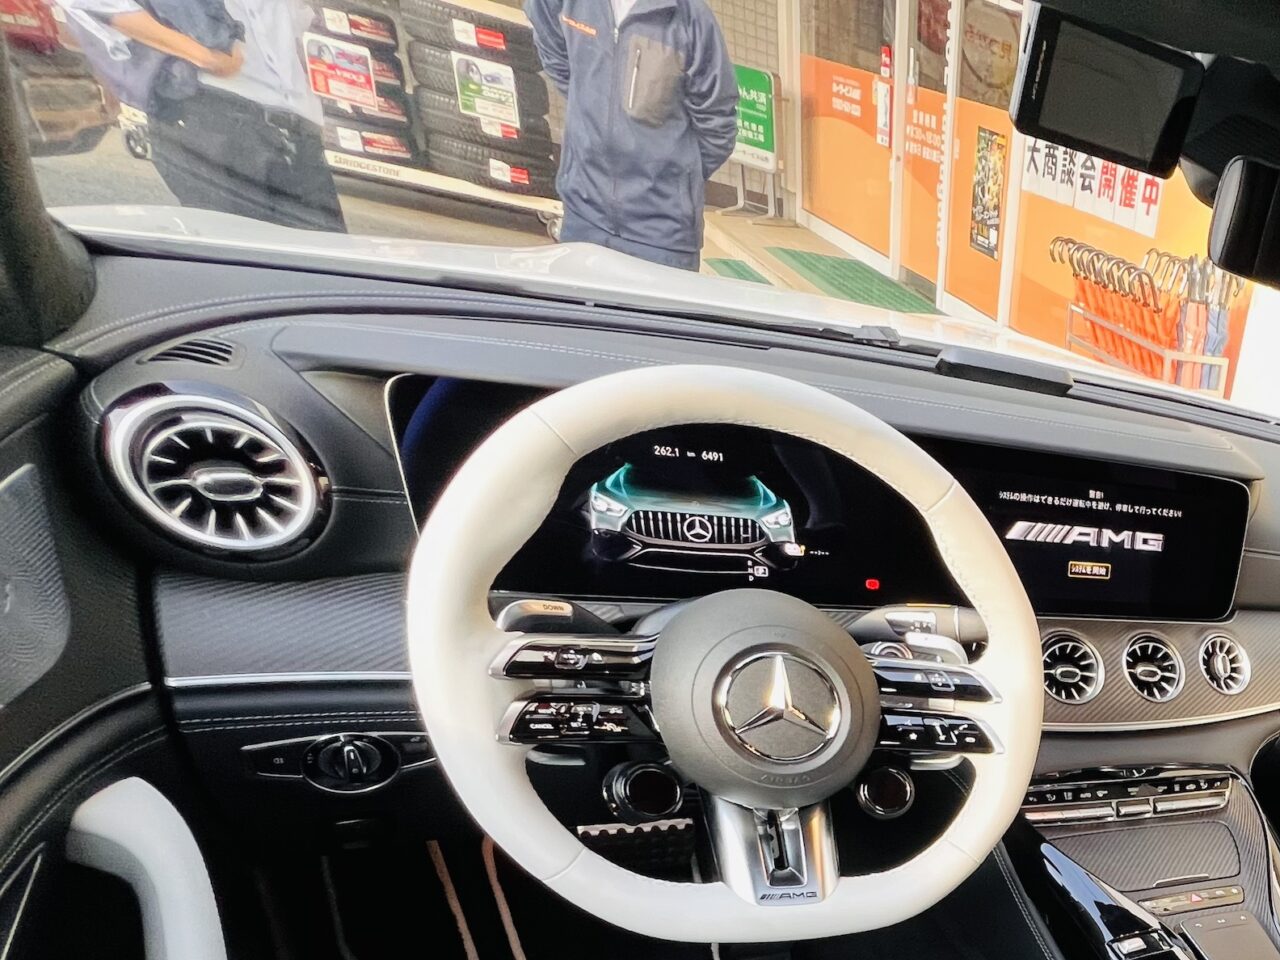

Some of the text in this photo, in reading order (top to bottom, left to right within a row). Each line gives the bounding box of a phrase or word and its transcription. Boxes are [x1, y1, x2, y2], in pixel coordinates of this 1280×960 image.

[1026, 138, 1160, 216] 大商談会開催中
[654, 445, 680, 458] 262.1
[701, 450, 724, 462] 6491
[1061, 525, 1165, 552] AMG
[542, 604, 565, 612] DOWN
[779, 891, 818, 900] AMG
